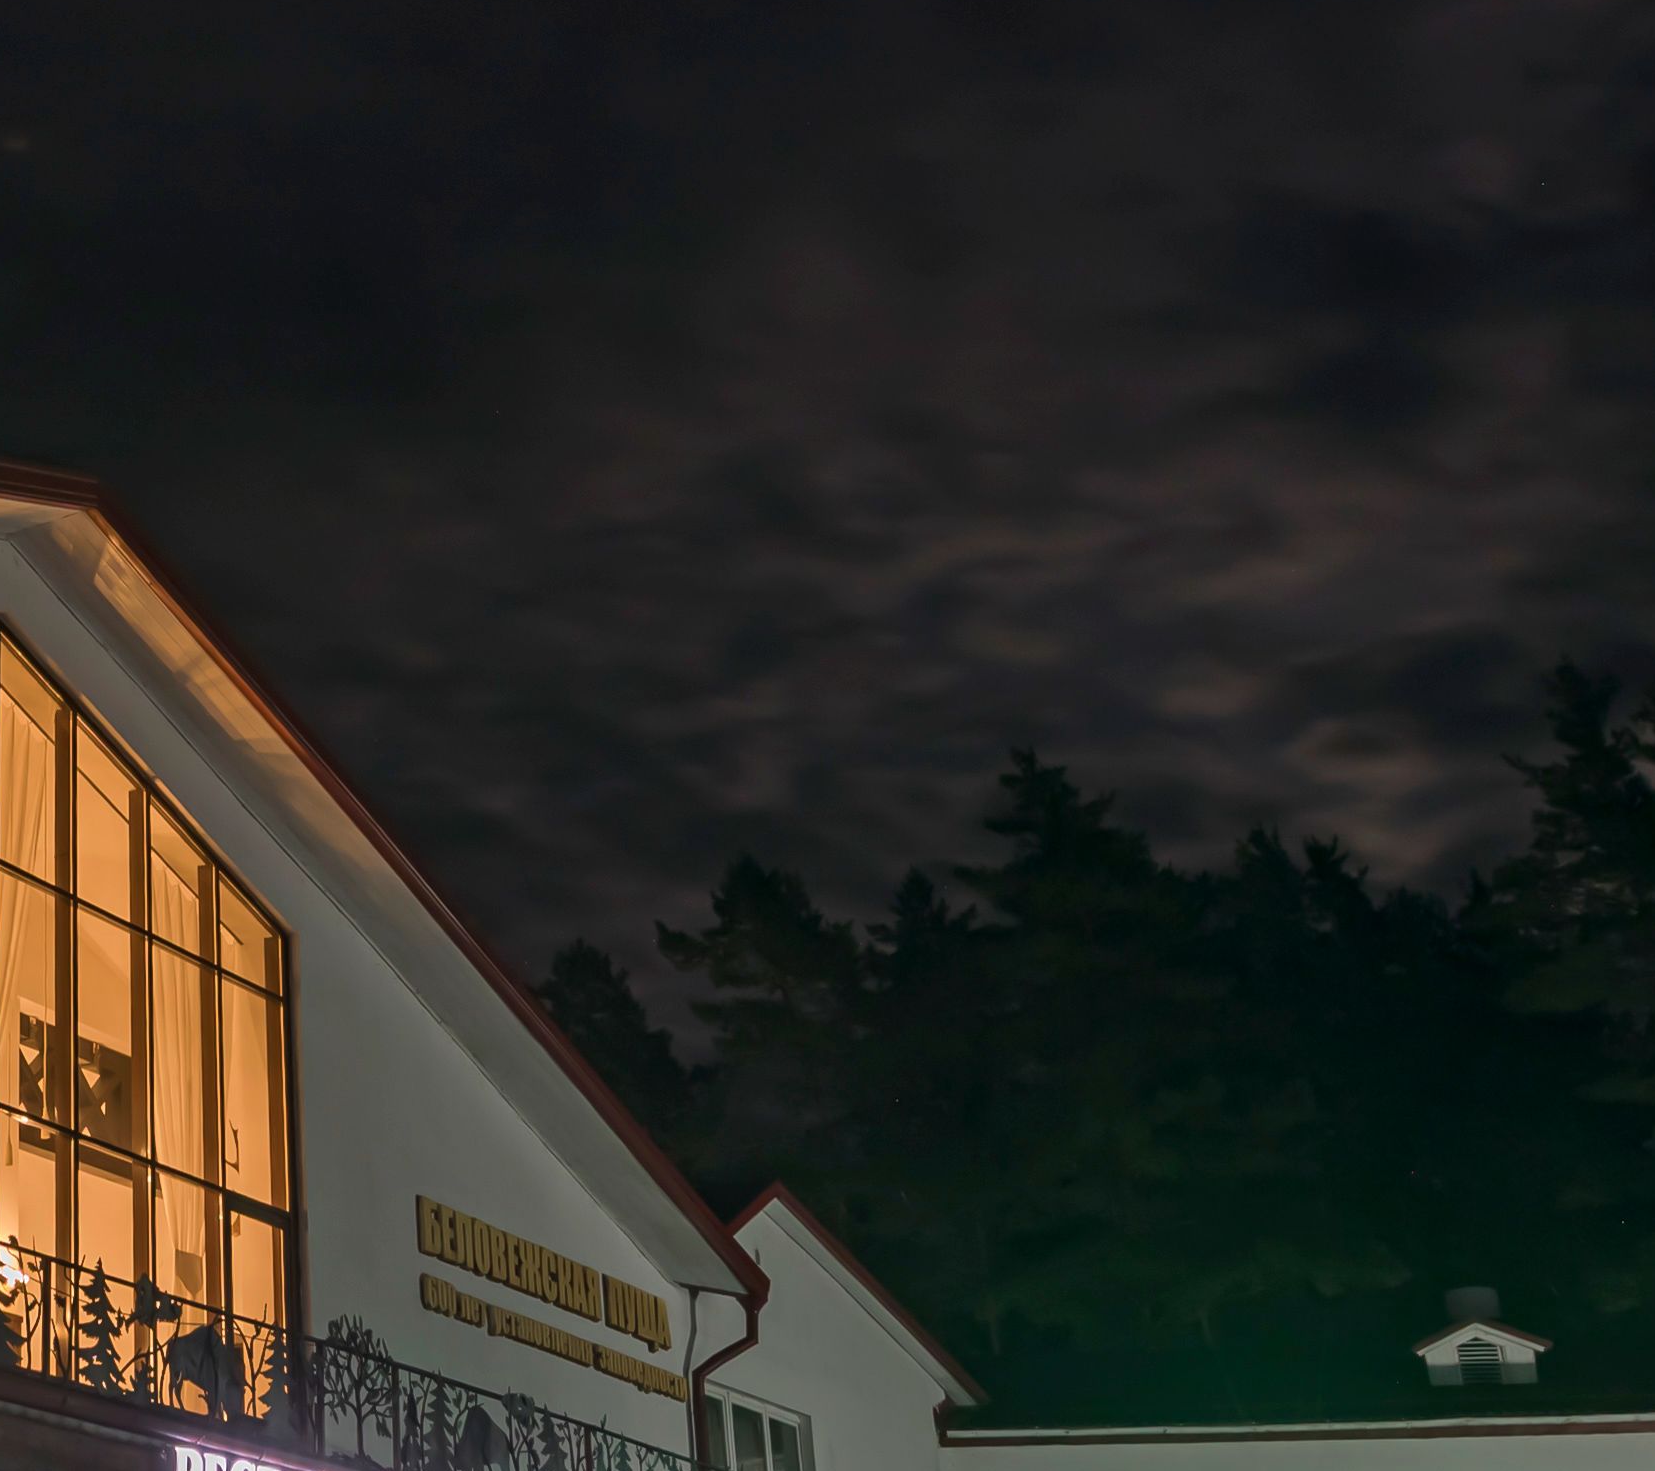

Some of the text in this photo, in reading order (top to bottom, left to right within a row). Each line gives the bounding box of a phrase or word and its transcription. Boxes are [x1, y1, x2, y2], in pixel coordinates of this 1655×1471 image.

[416, 1194, 671, 1353] БЕЛОВЕЖСКАЯ ПУЩА
[420, 1272, 457, 1317] 600
